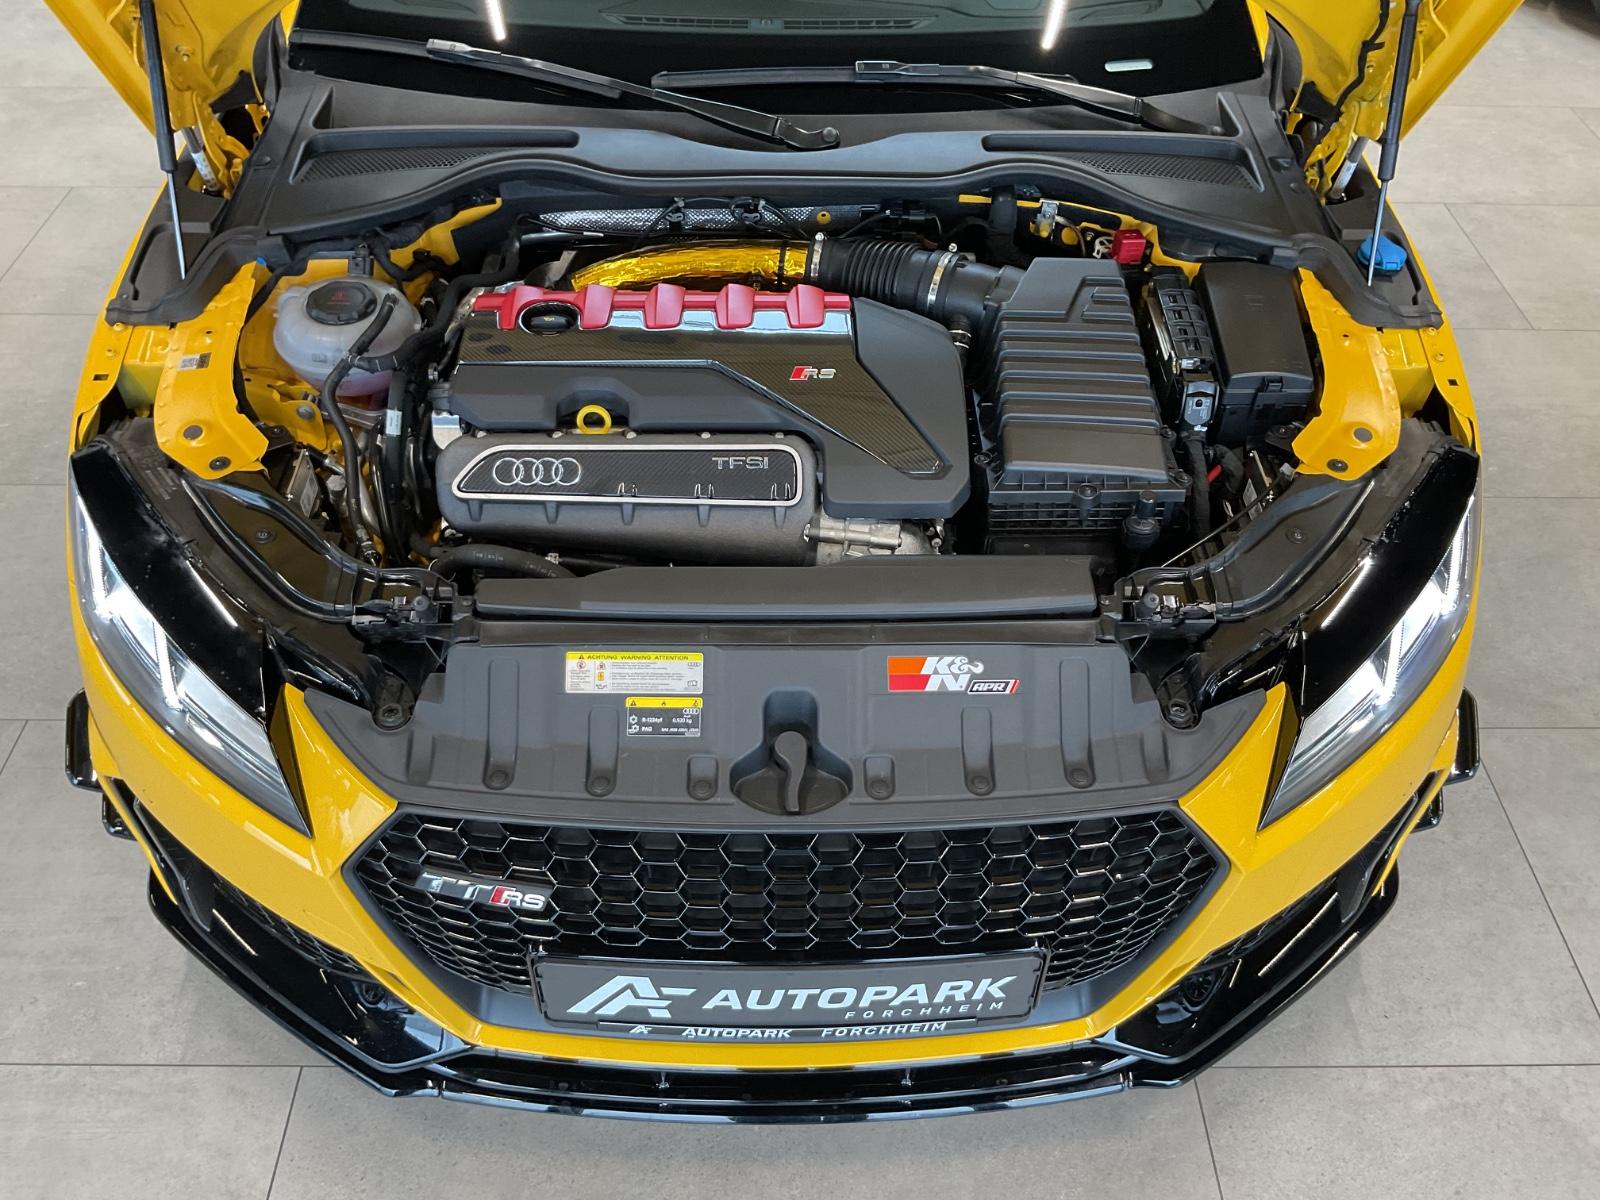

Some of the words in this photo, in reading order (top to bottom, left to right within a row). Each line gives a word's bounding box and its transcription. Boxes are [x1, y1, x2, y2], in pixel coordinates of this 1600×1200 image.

[789, 365, 837, 381] RS
[711, 456, 769, 470] TFSI
[971, 682, 1006, 692] APR
[701, 975, 1018, 1010] AUTOPARK
[844, 1001, 1004, 1020] FORCHHEIM
[681, 1026, 792, 1038] AUTOPARK
[820, 1021, 947, 1039] FORCHHEIM
